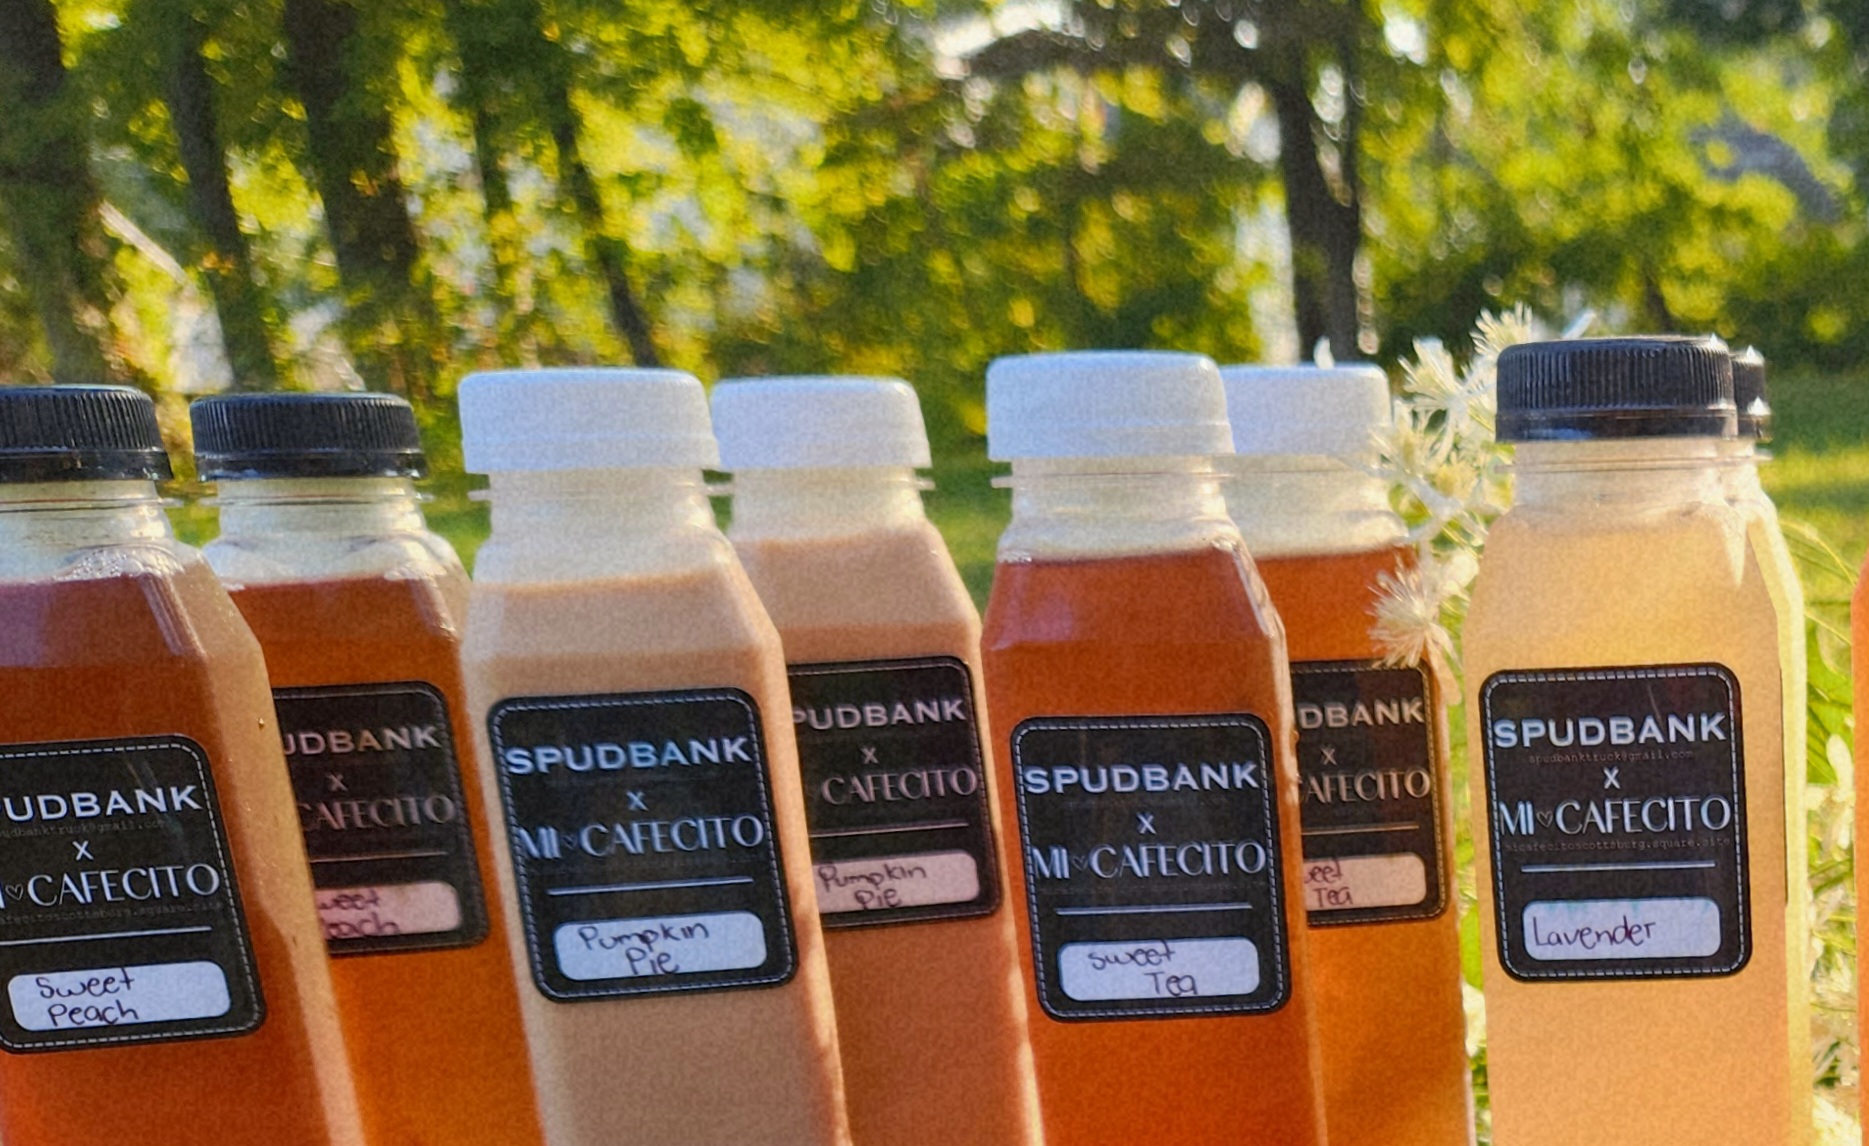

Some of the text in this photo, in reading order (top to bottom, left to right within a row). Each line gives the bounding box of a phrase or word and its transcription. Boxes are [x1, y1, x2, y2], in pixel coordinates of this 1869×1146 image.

[1493, 712, 1728, 749] SPUDBANK
[505, 736, 752, 775] SPUDBANK
[820, 767, 978, 805] CAFECITO
[1024, 761, 1260, 794] SPUDBANK
[1299, 767, 1431, 804] AFECITO
[0, 785, 203, 822] UDBANK
[1499, 793, 1732, 836] MI CAFECITO
[518, 813, 765, 860] MI CAFECITO
[1031, 838, 1267, 879] MI CAFECITO
[1304, 858, 1342, 884] eet
[27, 863, 220, 907] CAFECITO
[817, 862, 927, 893] Pumpkin
[854, 888, 903, 910] Pie
[1313, 887, 1353, 908] Tea
[320, 911, 399, 939] each
[578, 922, 710, 953] Pumpkin
[1532, 915, 1658, 949] Lavender
[625, 947, 680, 976] Pie
[1144, 971, 1198, 998] Tea
